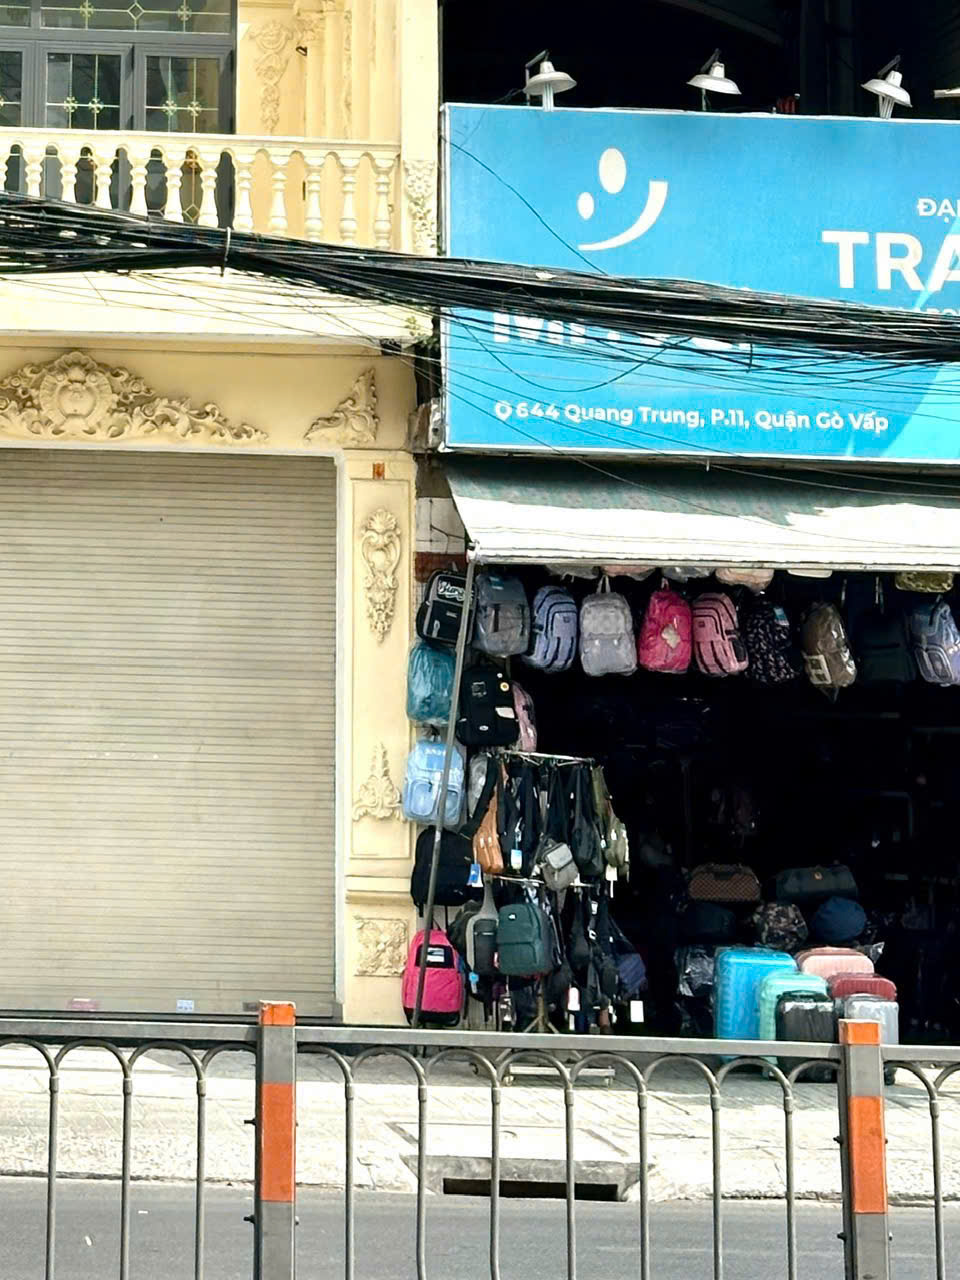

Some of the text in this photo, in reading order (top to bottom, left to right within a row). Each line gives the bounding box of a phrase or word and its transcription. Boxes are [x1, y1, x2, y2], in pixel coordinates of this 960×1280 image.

[516, 402, 889, 434] 644 Quang Trung, P.11, Quận Gò Vấp
